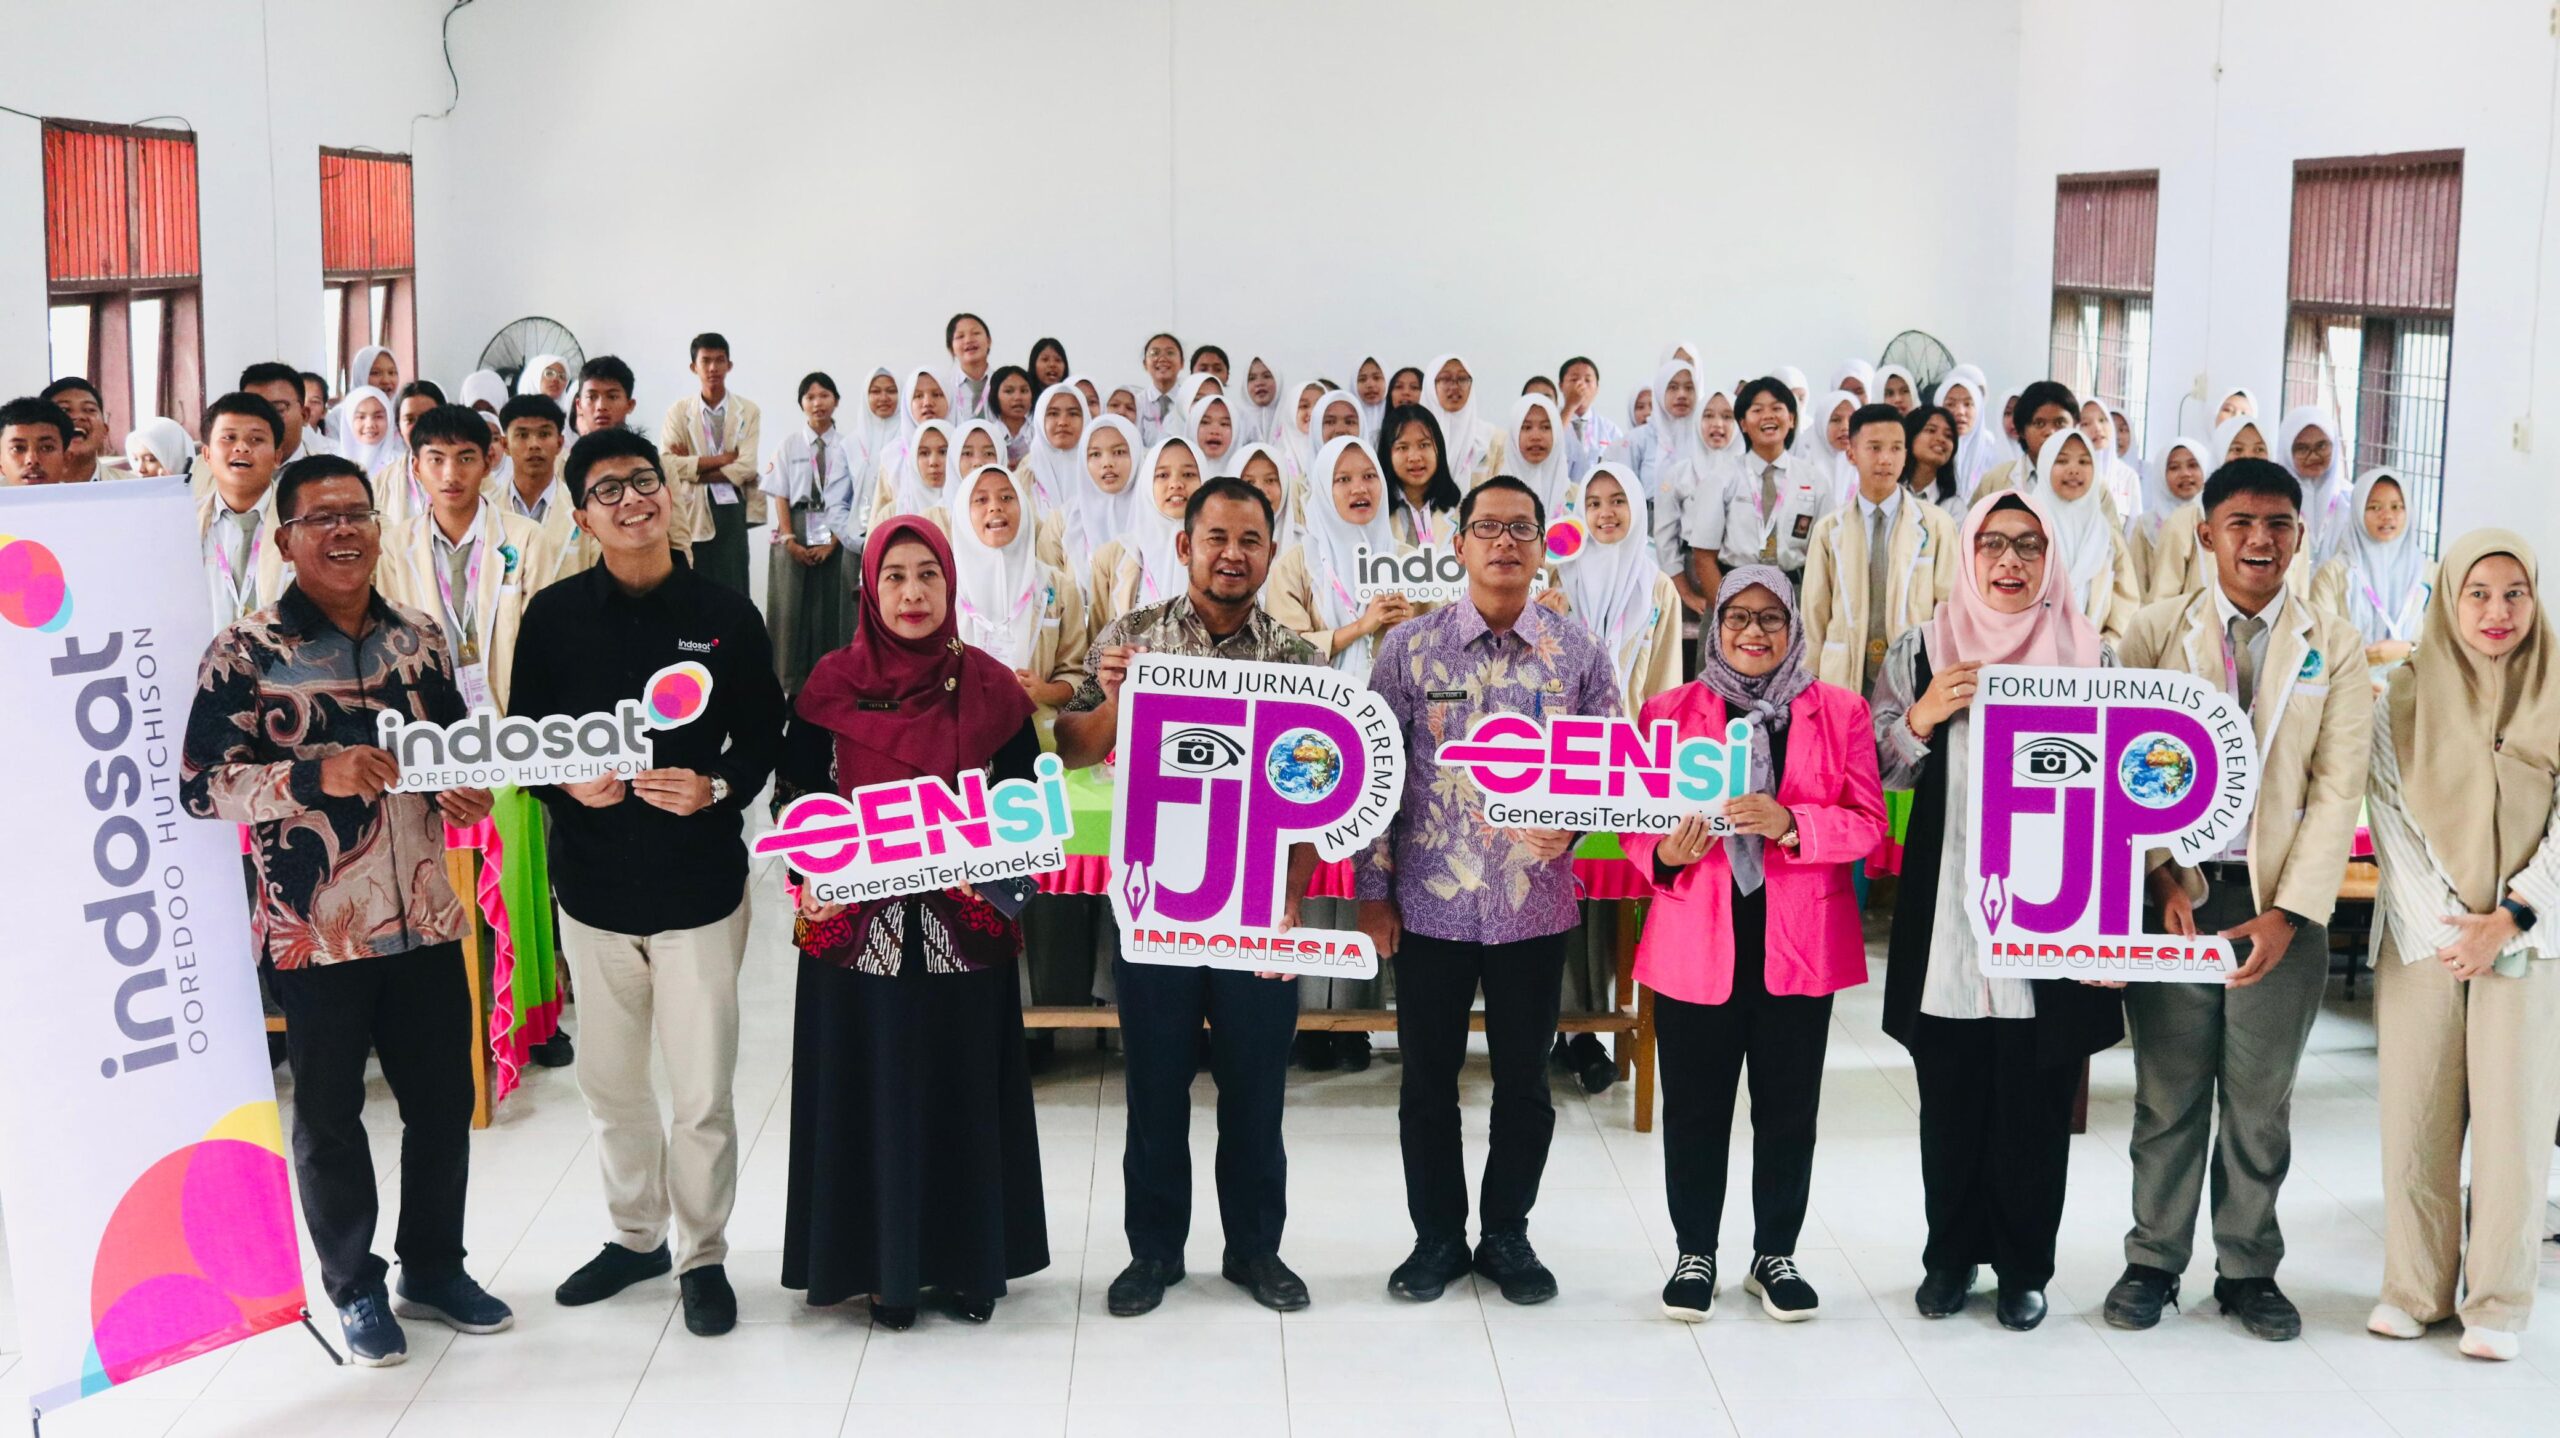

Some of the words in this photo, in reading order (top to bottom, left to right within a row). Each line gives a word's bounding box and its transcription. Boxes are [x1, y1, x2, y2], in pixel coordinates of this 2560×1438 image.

[133, 627, 178, 843] HUTCHISON
[384, 706, 646, 767] indosat
[1138, 665, 1227, 690] FORUM
[1233, 671, 1354, 708] JURNALIS
[1324, 704, 1393, 850] PEREMPUAN
[1988, 677, 2077, 698] FORUM
[2084, 679, 2205, 710] JURNALIS
[2180, 706, 2247, 854] PEREMPUAN
[519, 760, 647, 780] HUTCHISON
[1489, 803, 1732, 832] GenerasiTerkons
[50, 631, 179, 1079] indosat
[816, 846, 1061, 902] GenerasiTerkoneksi
[164, 865, 208, 1054] OOREDOO
[1133, 929, 1366, 967] INDONESIA
[1991, 943, 2225, 971] INDONESIA
